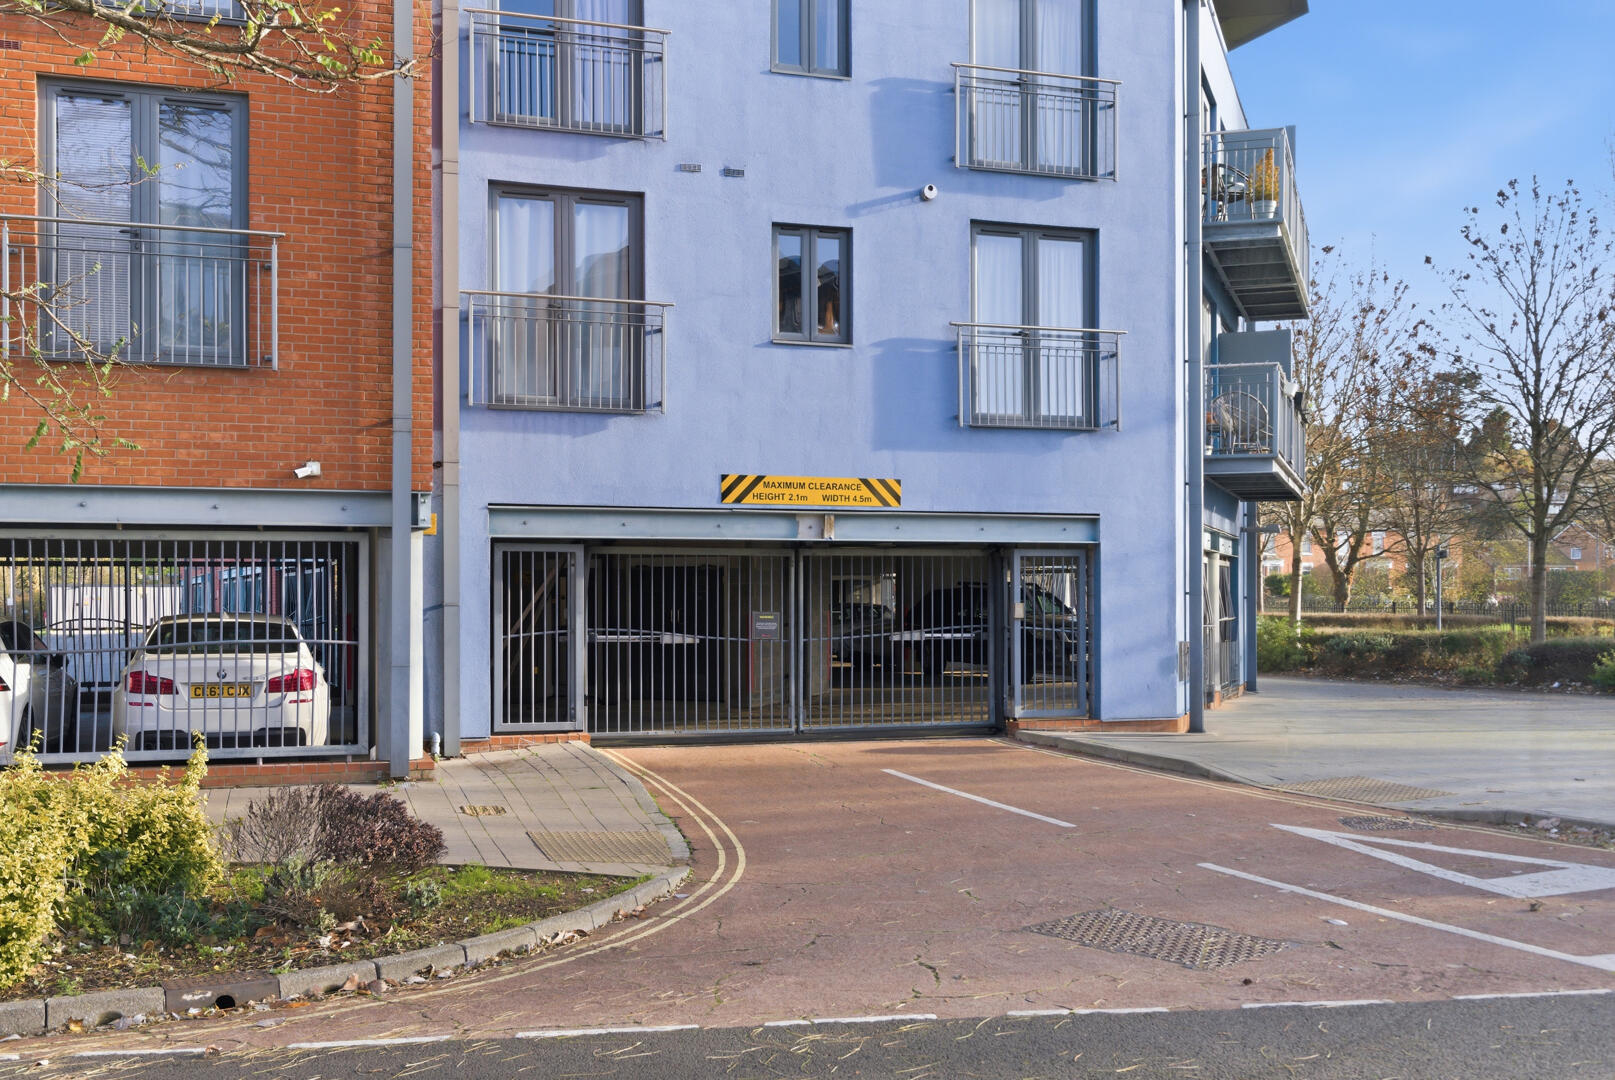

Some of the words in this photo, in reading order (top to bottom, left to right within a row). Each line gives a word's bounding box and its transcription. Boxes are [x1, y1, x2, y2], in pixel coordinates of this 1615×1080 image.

[763, 481, 806, 490] MAXIMUM
[808, 482, 862, 491] CLEARANCE
[752, 492, 786, 501] HEIGHT
[788, 494, 808, 502] 2.1m
[822, 494, 850, 502] WIDTH
[853, 495, 872, 503] 4.5m
